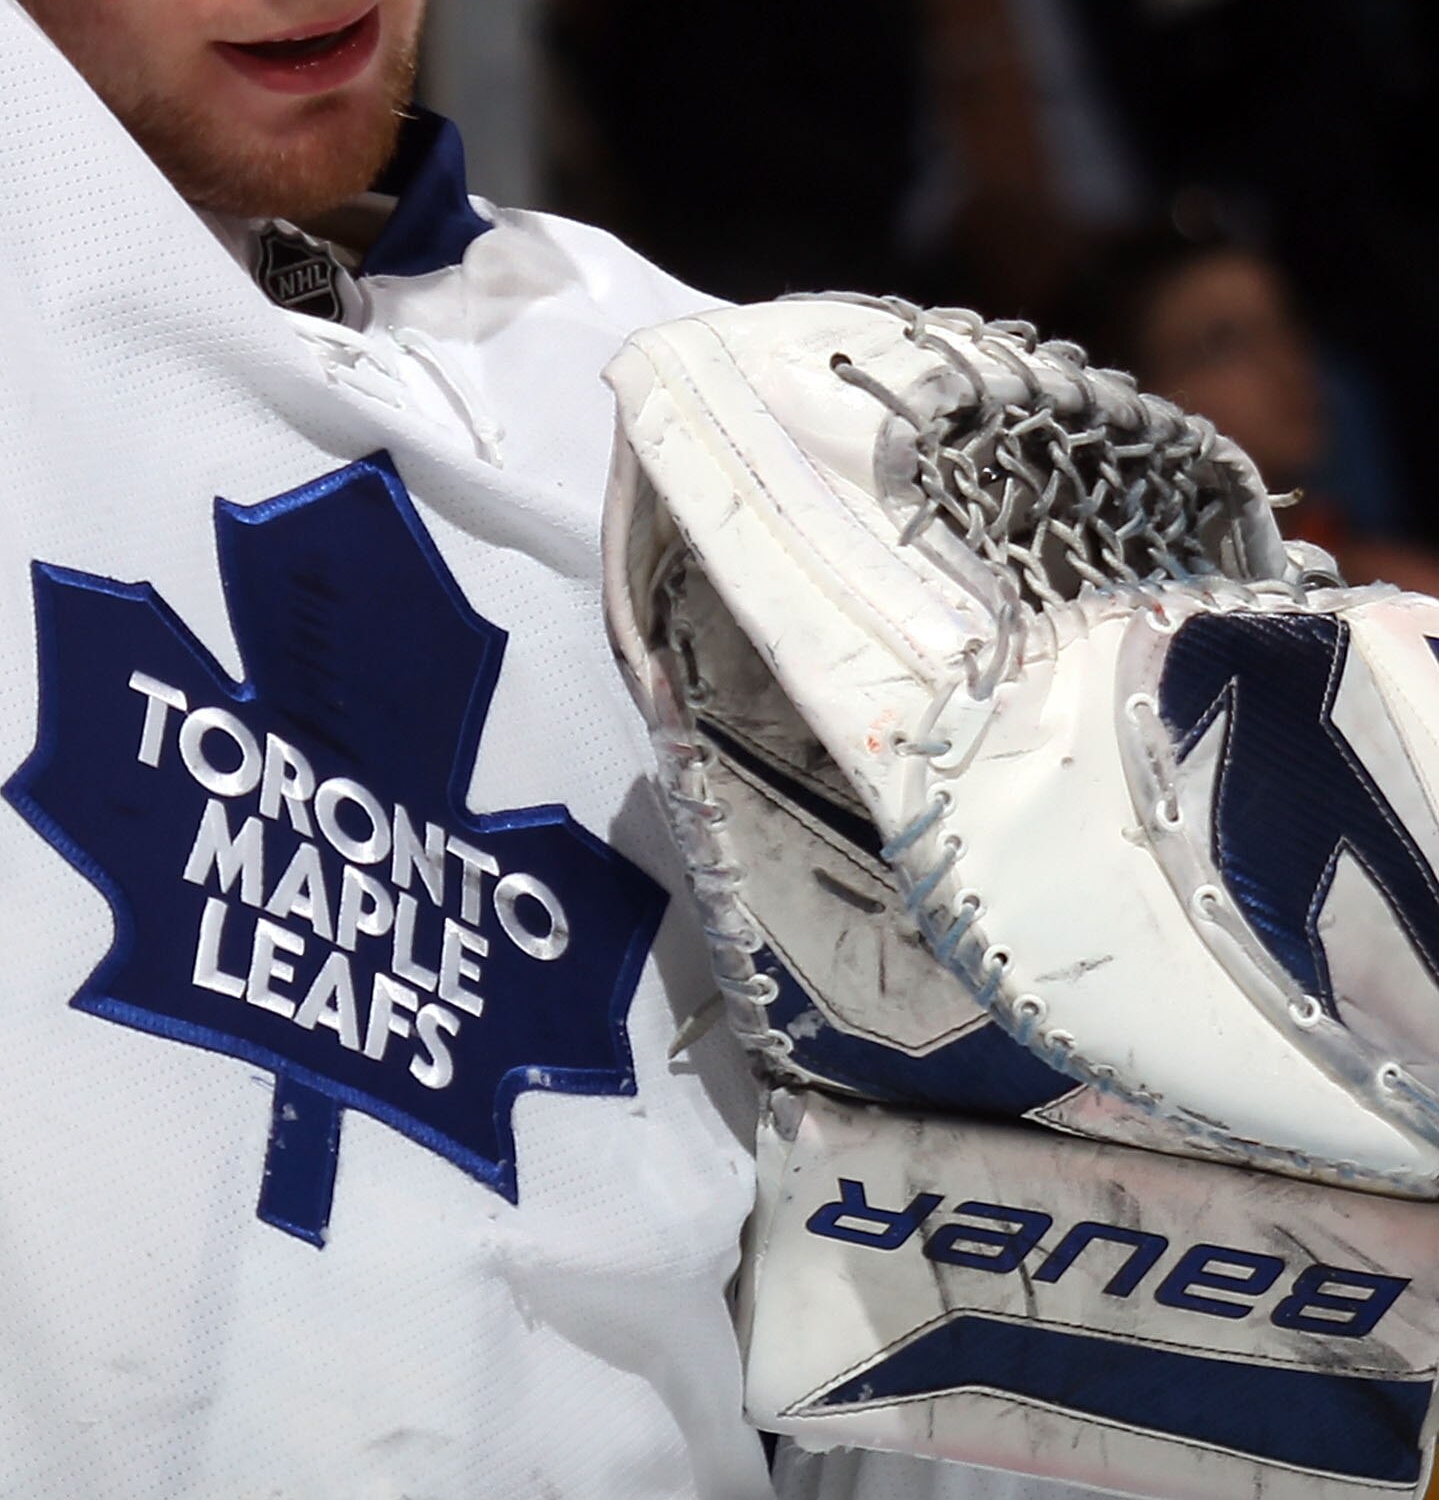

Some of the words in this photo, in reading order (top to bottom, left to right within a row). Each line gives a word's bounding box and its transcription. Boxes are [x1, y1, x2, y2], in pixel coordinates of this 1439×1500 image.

[278, 264, 328, 298] NHL
[128, 670, 570, 961] TORONTO
[182, 798, 490, 1018] MAPLE
[192, 896, 461, 1090] LEAFS
